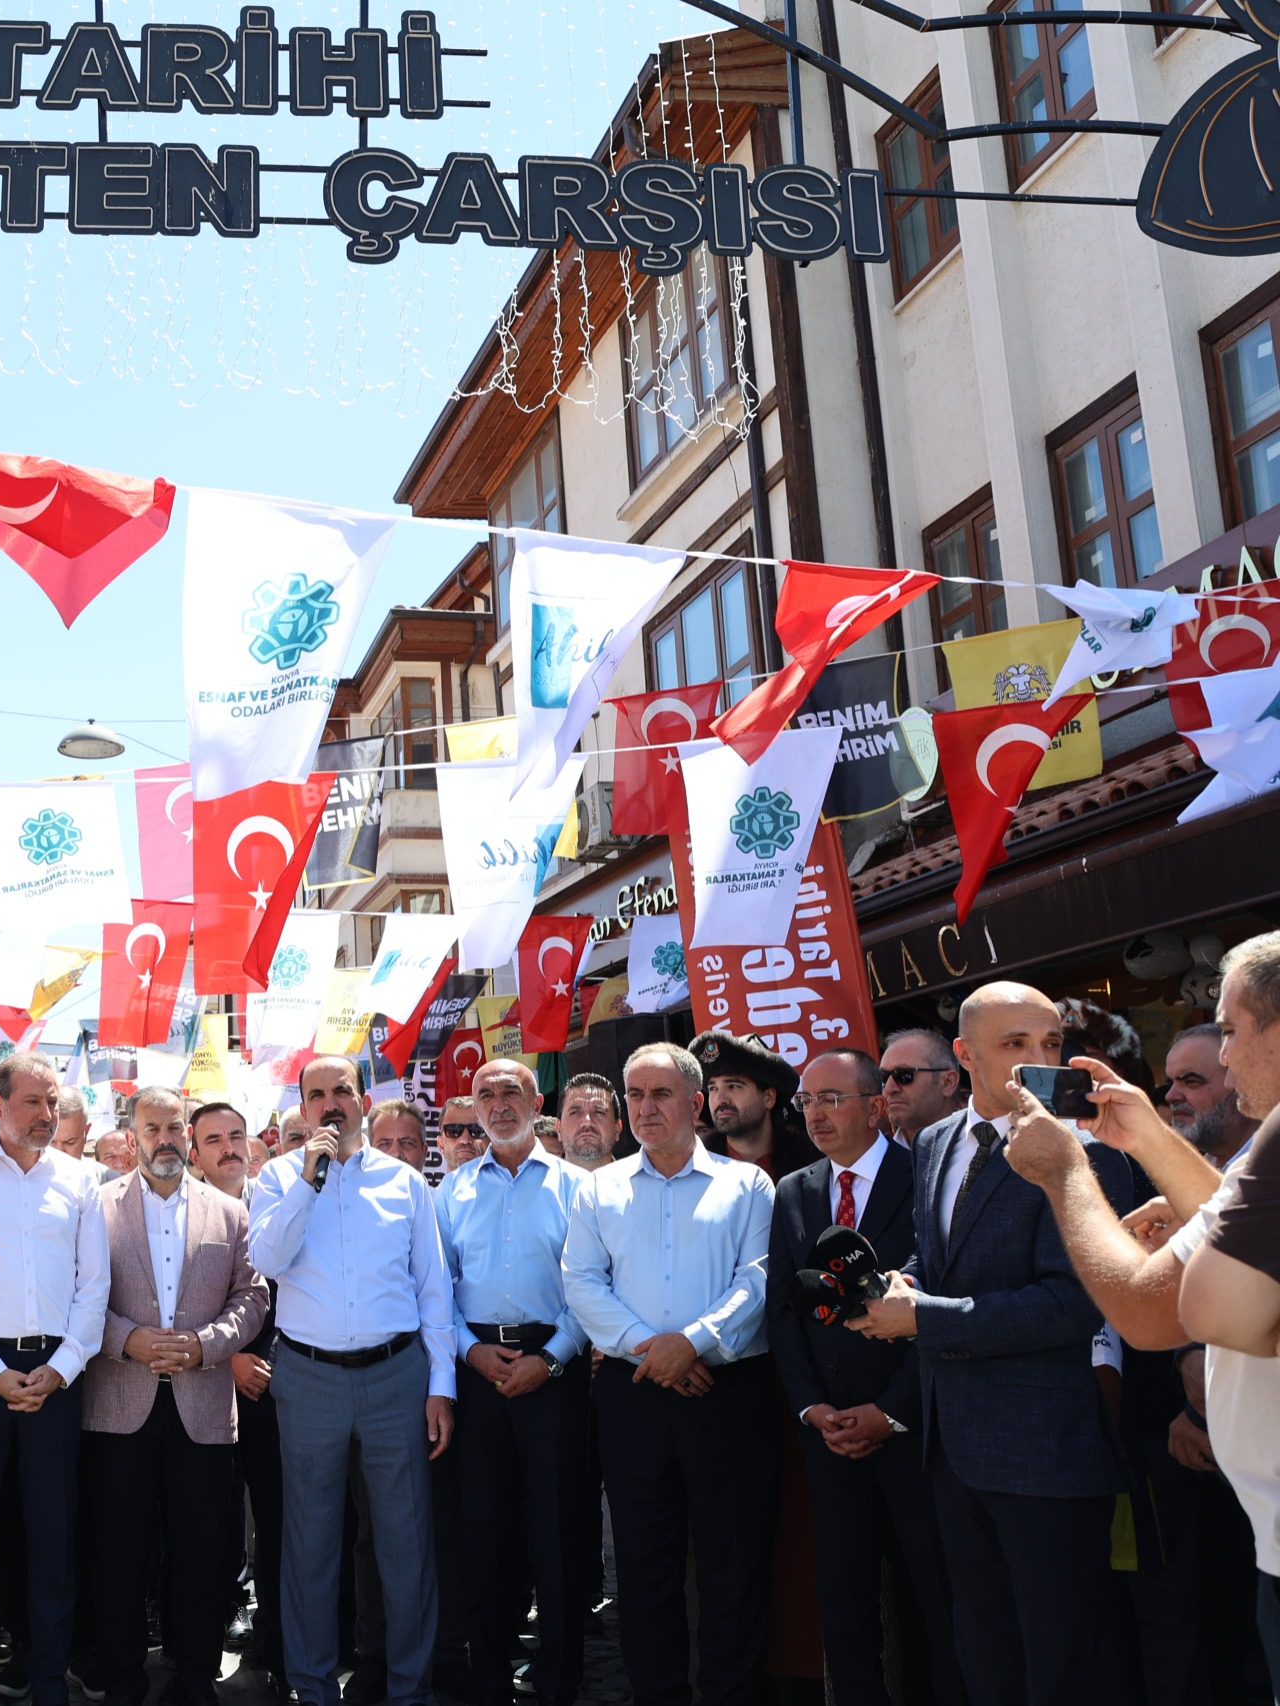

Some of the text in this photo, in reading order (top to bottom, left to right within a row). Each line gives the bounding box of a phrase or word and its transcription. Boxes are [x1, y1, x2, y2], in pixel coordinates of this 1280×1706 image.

[323, 147, 889, 276] ÇARŞISI
[199, 676, 338, 703] ESNAF VE SANATKAR
[271, 668, 300, 685] KONYA
[231, 697, 285, 718] ODALARI
[834, 730, 900, 764] HRİM
[616, 861, 678, 929] Efend
